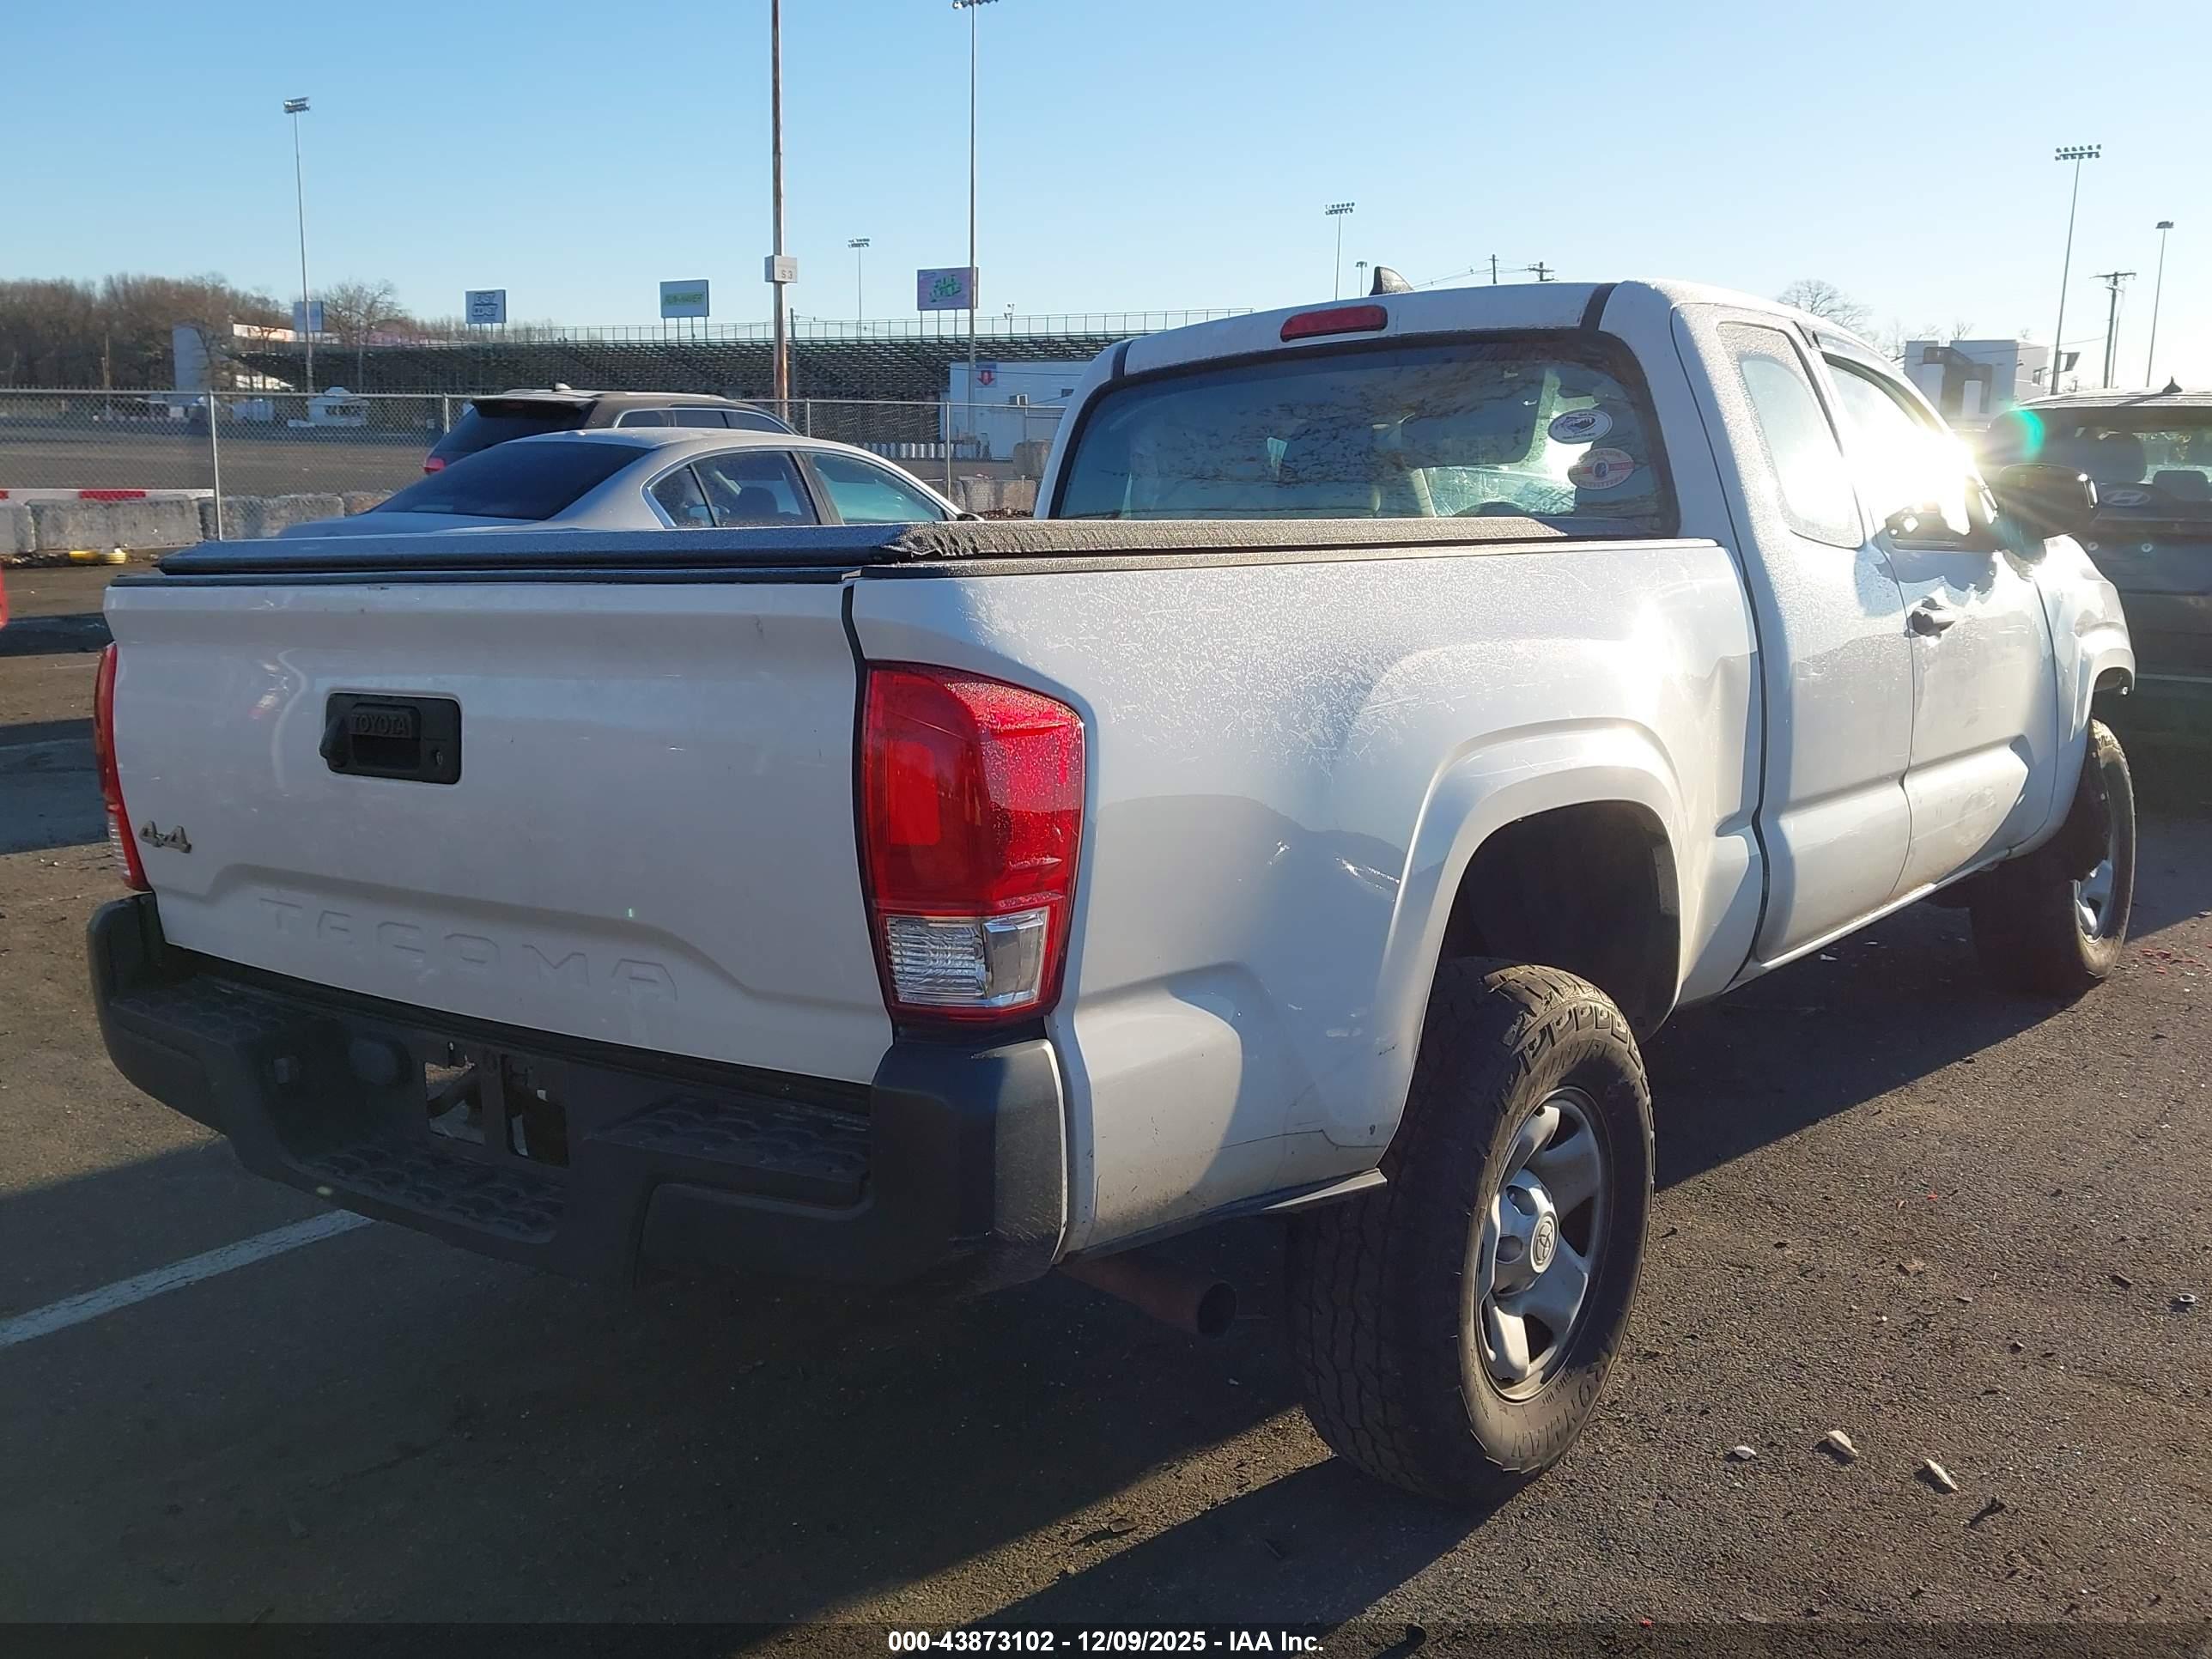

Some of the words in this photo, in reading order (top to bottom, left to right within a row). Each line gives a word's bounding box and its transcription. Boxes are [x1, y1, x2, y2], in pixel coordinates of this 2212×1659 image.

[350, 714, 406, 736] TOYOTA
[138, 820, 192, 854] 4x4
[260, 897, 678, 1002] TACOMA
